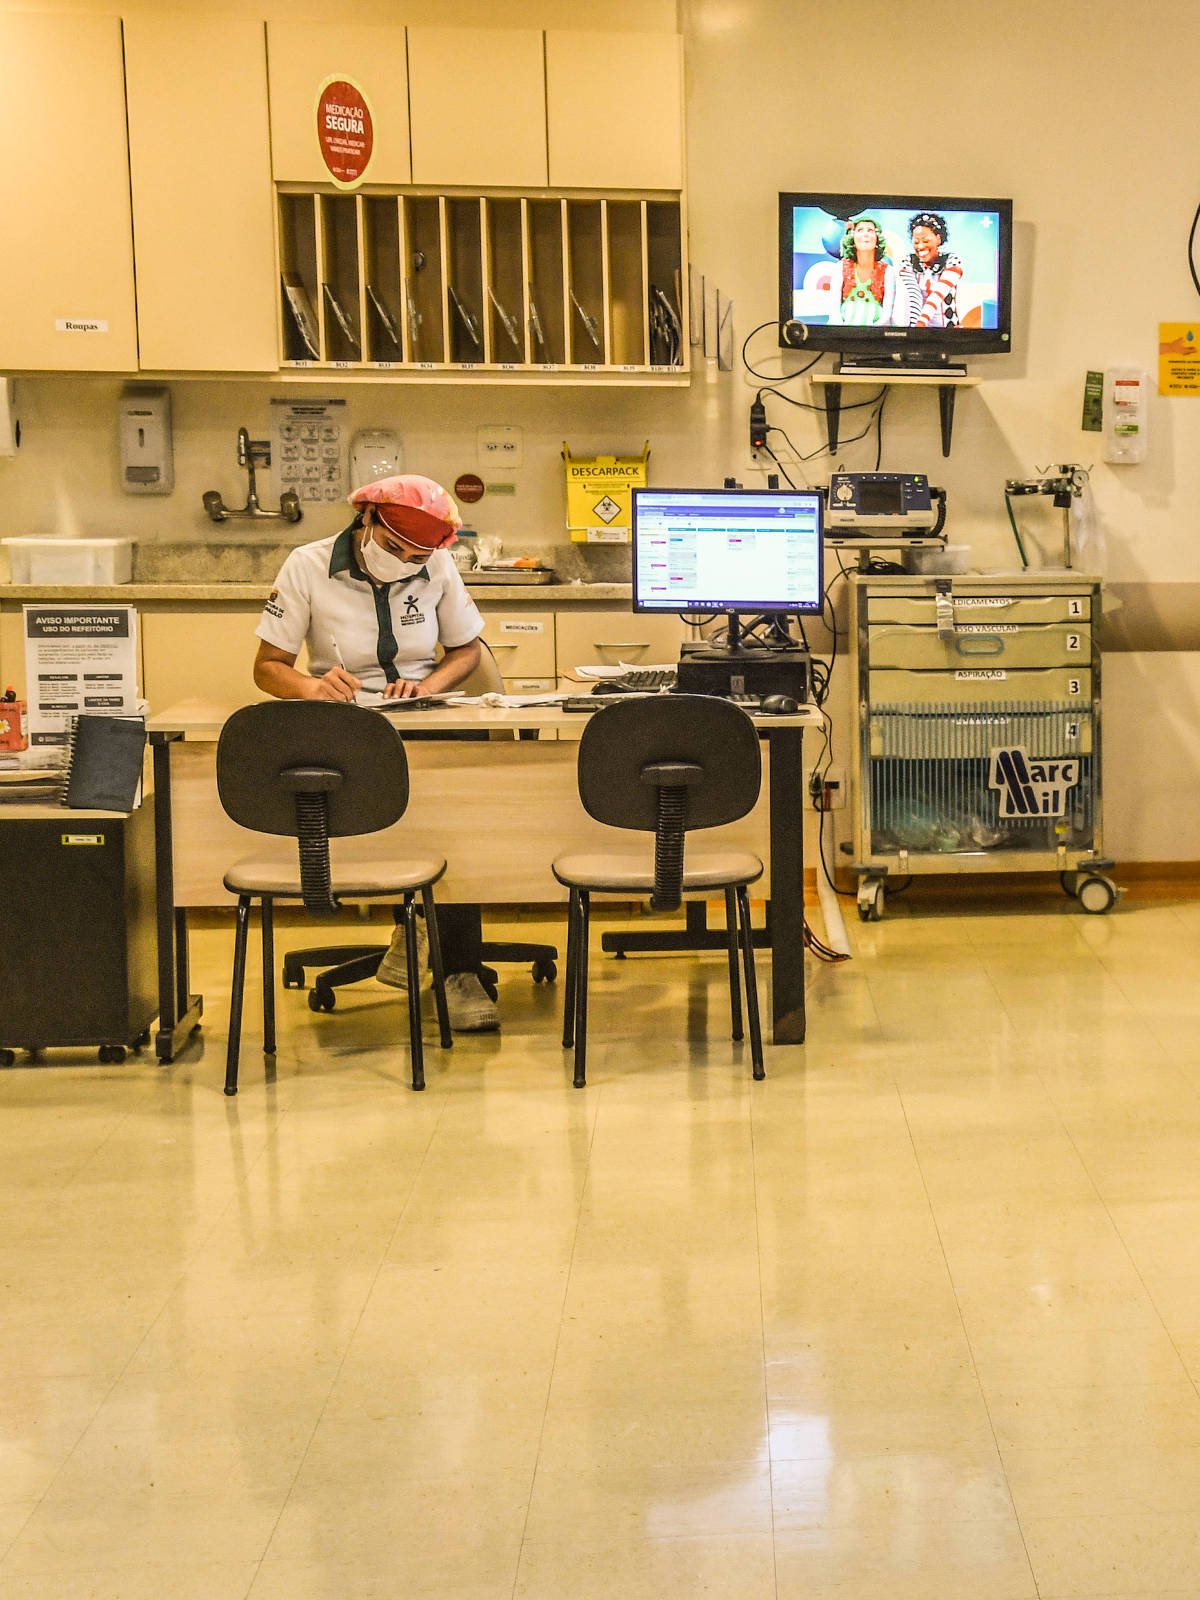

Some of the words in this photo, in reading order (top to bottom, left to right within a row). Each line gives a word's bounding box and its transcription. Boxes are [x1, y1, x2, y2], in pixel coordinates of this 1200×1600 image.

[325, 103, 364, 119] MEDICAÇÃO
[325, 115, 365, 135] SEGURA
[65, 321, 98, 332] Roupas
[571, 466, 639, 477] DESCARPACK
[953, 598, 1010, 606] EDICAMENTOS
[1071, 602, 1080, 614] 1
[36, 616, 62, 625] AVISO
[63, 616, 120, 625] IMPORTANTE
[71, 624, 114, 632] REFEITÓRIO
[977, 625, 1018, 633] VASCULAR
[1069, 636, 1078, 649] 2
[957, 671, 1004, 680] ASPIRAÇÃO
[1070, 681, 1079, 694] 3
[1068, 725, 1077, 737] 4
[995, 749, 1073, 785] Marc
